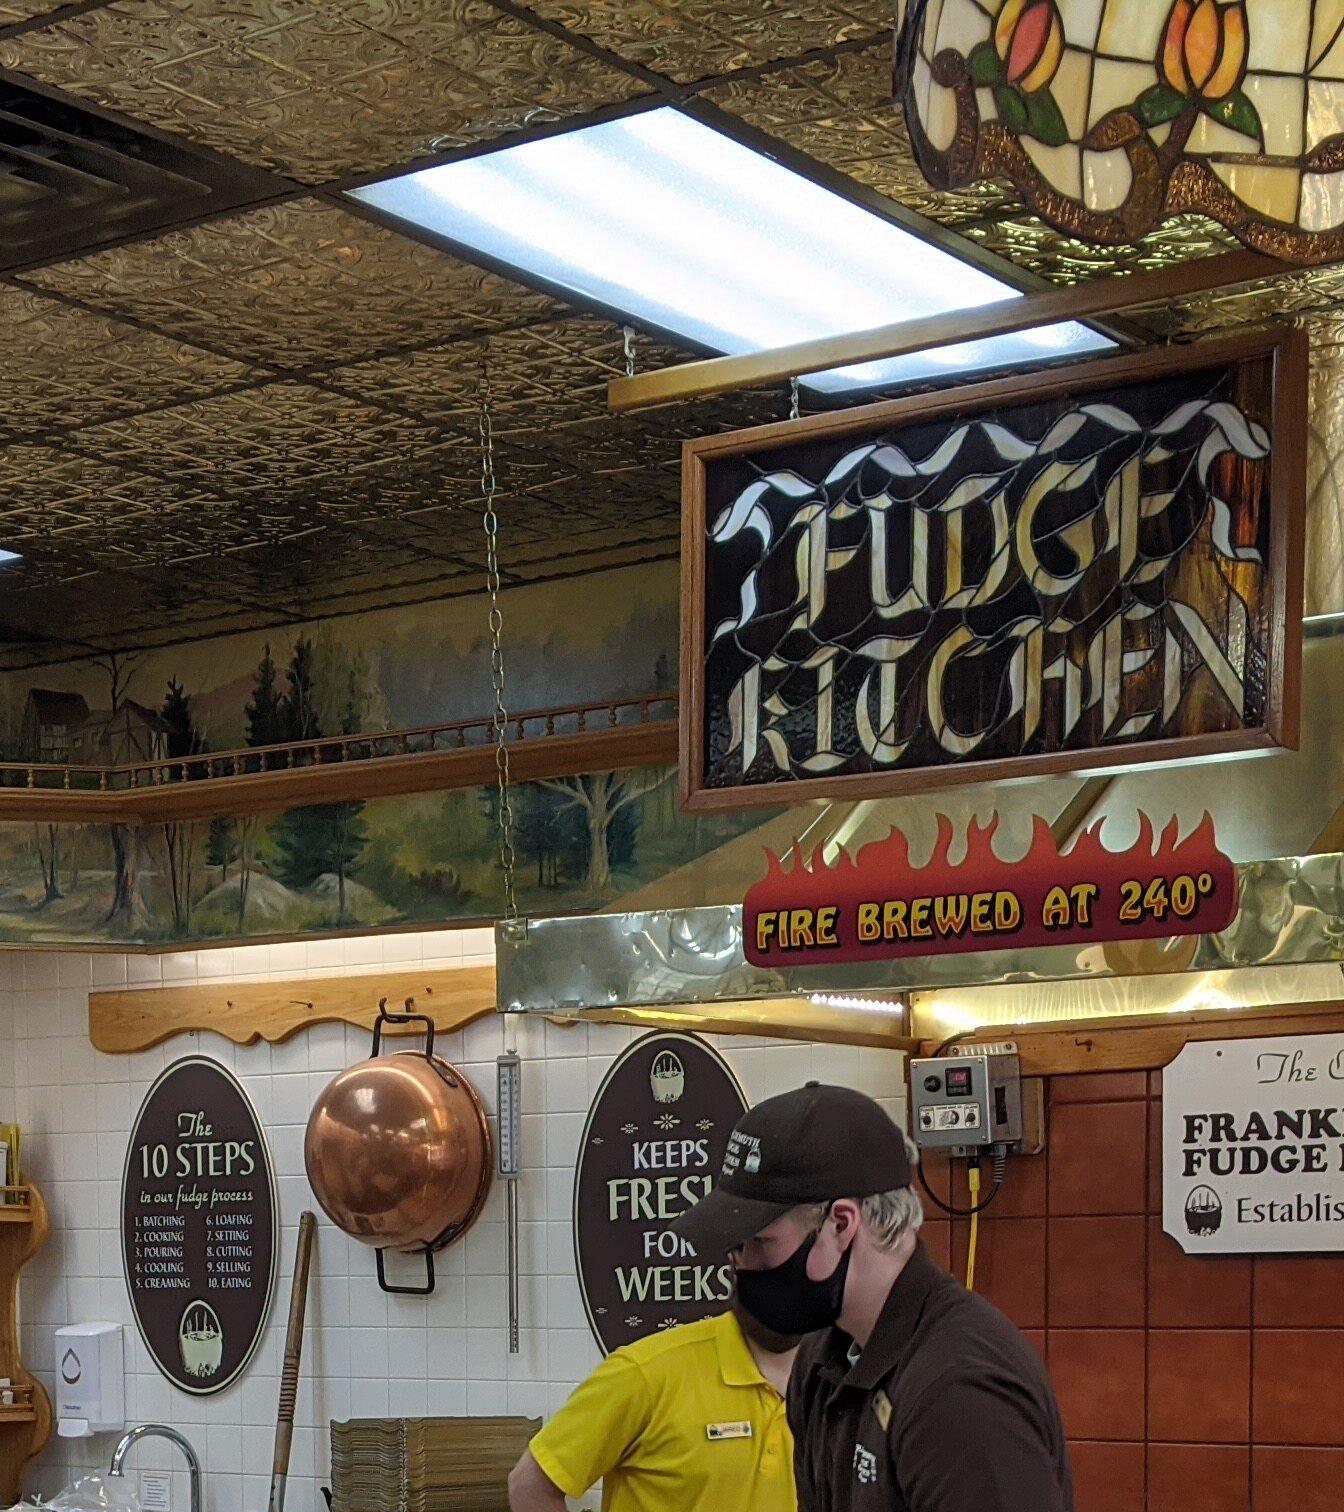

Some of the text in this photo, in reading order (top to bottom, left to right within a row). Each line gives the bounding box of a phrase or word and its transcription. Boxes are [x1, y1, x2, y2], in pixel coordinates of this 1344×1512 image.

[788, 445, 1180, 632] FUDGE
[726, 600, 1246, 776] KITCHEN
[756, 906, 839, 950] FIRE
[857, 891, 1021, 941] BREWED
[1042, 883, 1097, 927] AT
[1256, 1049, 1317, 1084] The
[177, 1111, 213, 1138] The
[139, 1141, 255, 1179] 10 STEPS
[632, 1139, 709, 1169] KEEPS
[1181, 1143, 1329, 1177] FUDGE
[140, 1183, 254, 1211] in our fudge process
[134, 1215, 185, 1227] 1. BATCHING
[206, 1214, 253, 1226] 6. LOAFING
[134, 1231, 184, 1243] 2. COOKING
[206, 1230, 249, 1241] 7. SETTING
[135, 1246, 183, 1258] 3. POURING
[206, 1246, 252, 1257] 8. CUTTING
[134, 1262, 184, 1273] 4. COOLING
[206, 1261, 251, 1273] 9. SELLING
[135, 1277, 191, 1289] 5. CREAMING
[208, 1277, 252, 1289] 10. EATING
[614, 1264, 733, 1302] WEEKS
